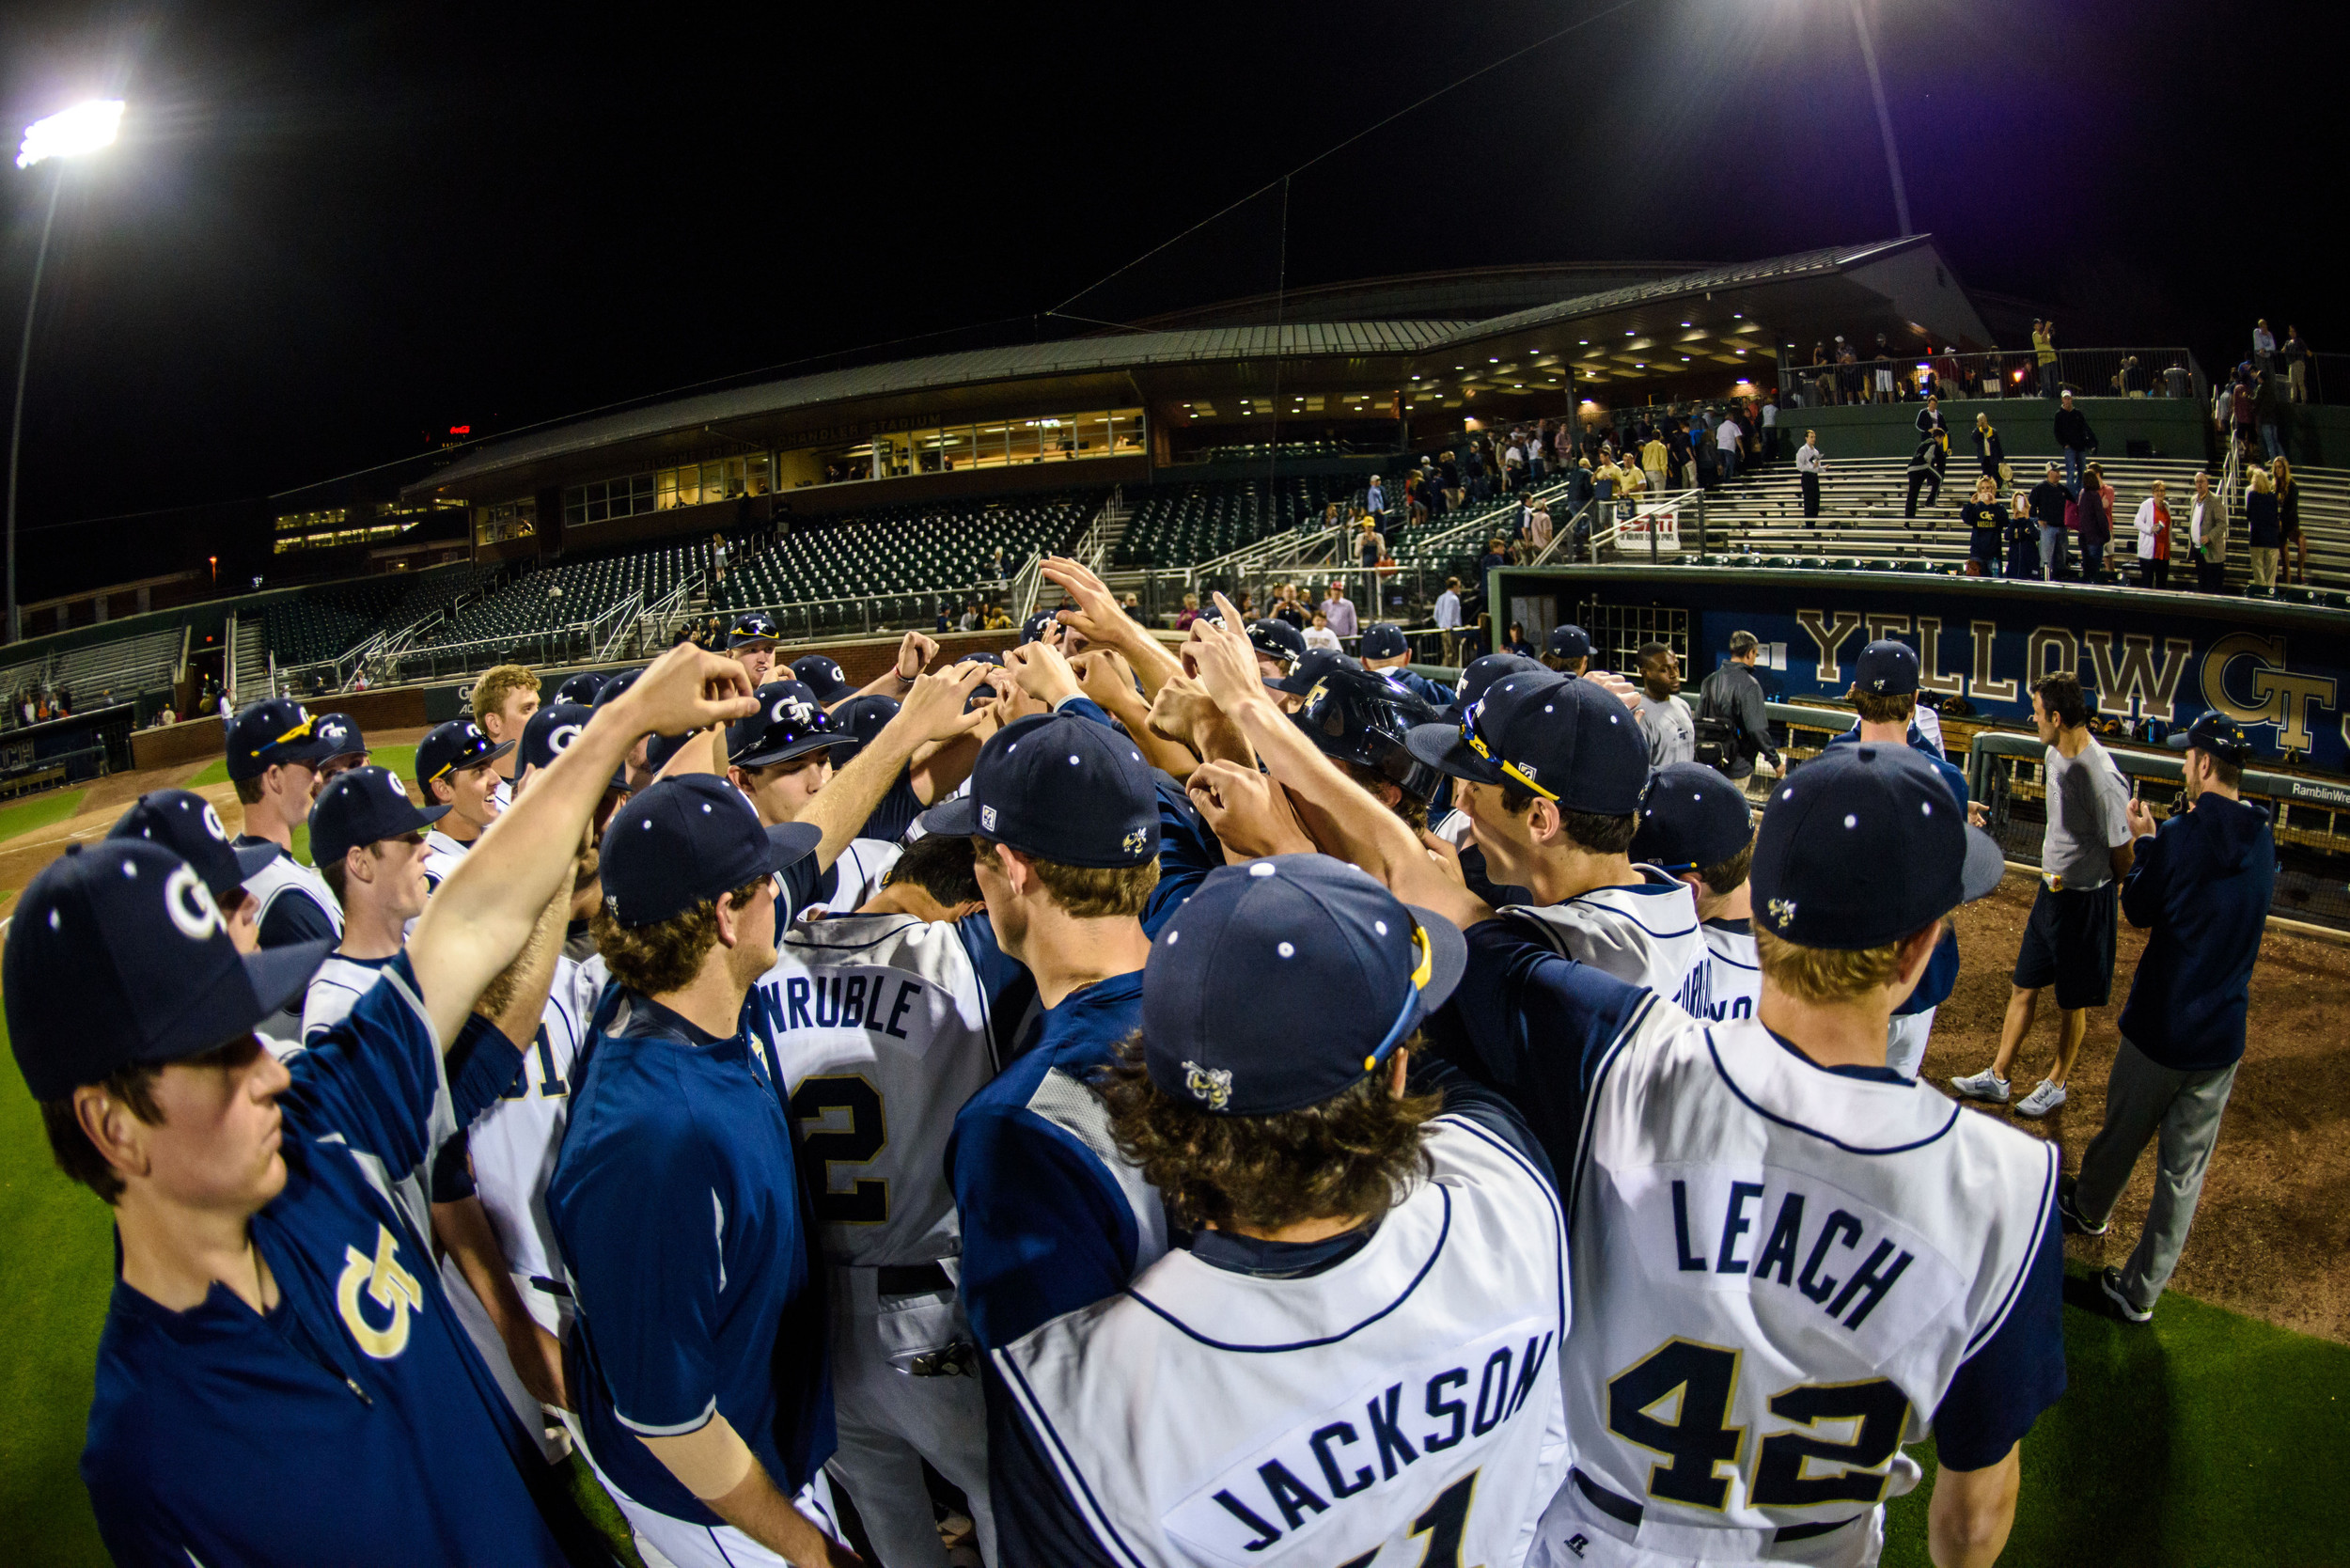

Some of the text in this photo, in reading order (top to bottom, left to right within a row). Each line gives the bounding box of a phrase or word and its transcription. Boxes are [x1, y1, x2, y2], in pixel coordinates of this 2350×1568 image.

[868, 414, 941, 433] STADIUM
[1671, 1180, 1915, 1331] LEACH
[1212, 1330, 1554, 1552] JACKSON
[1606, 1334, 1912, 1513] 42
